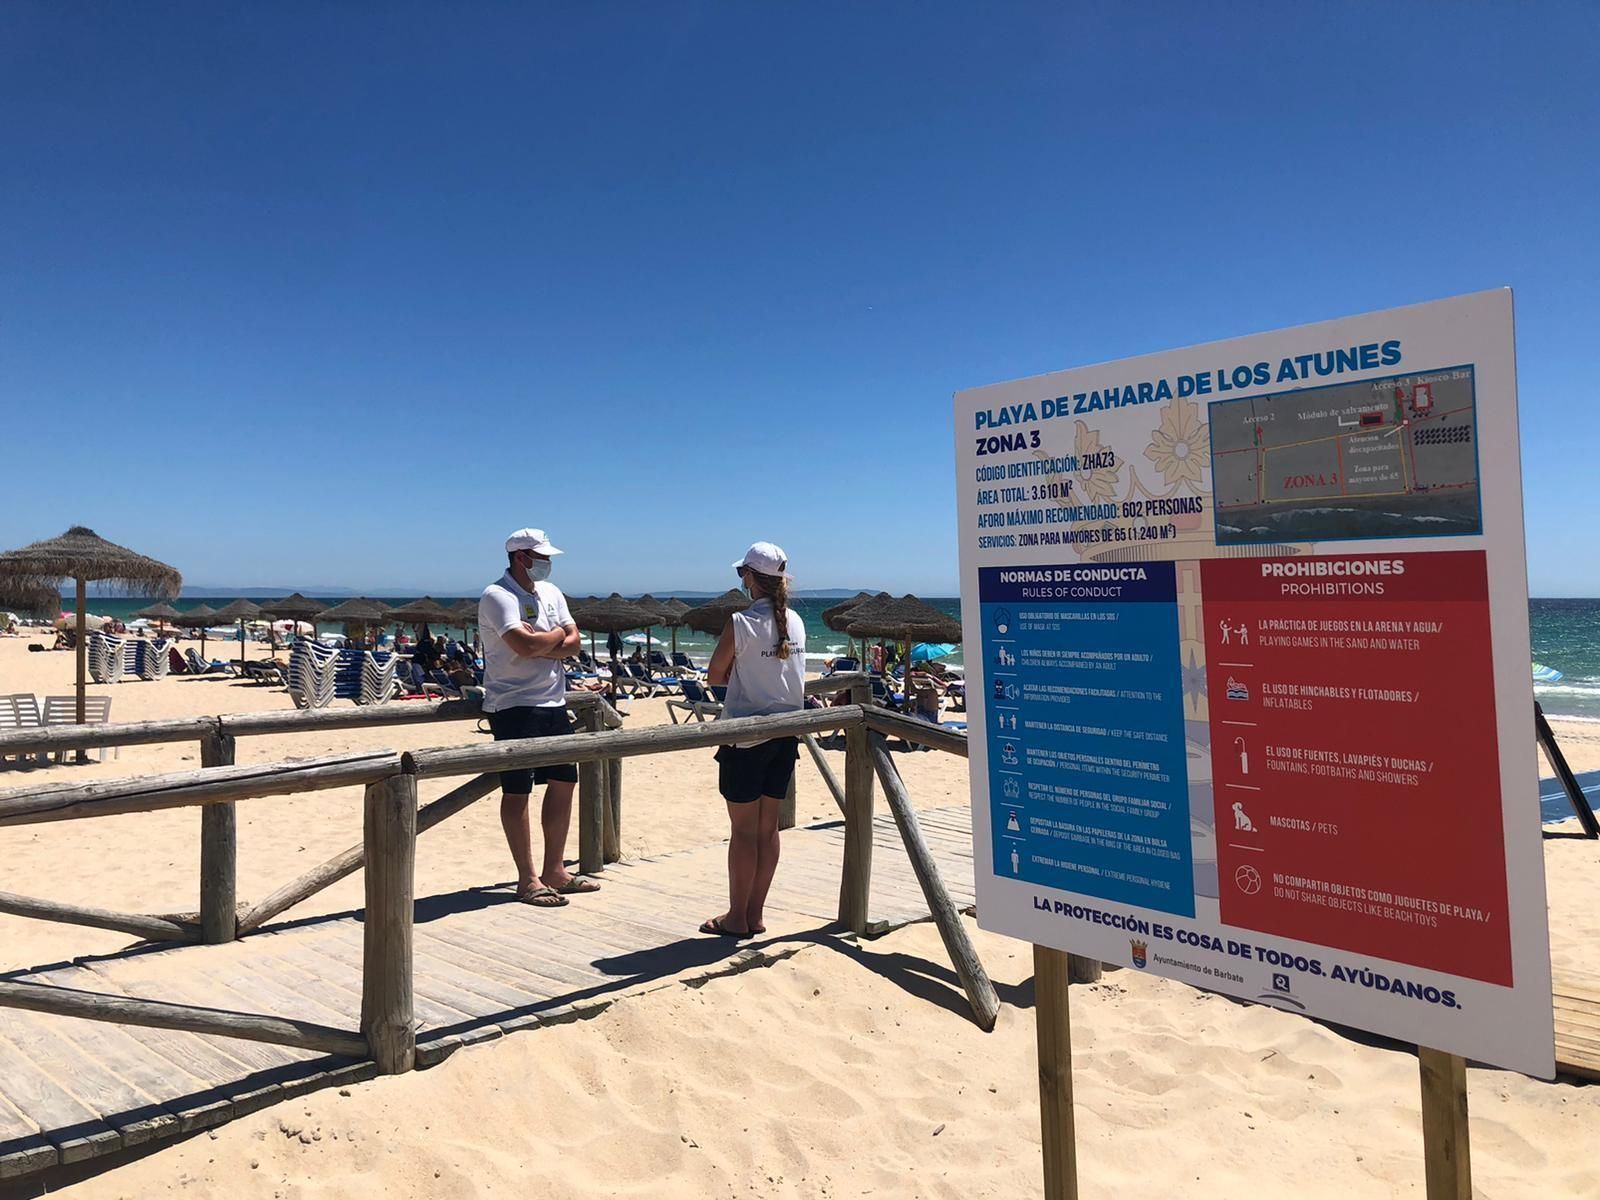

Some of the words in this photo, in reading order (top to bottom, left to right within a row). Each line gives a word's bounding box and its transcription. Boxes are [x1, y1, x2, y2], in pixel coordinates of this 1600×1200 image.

[976, 403, 1038, 430] PLAYA
[1041, 396, 1069, 419] DE
[1073, 379, 1173, 414] ZAHARA
[1177, 371, 1212, 398] DE
[1217, 362, 1270, 391] LOS
[1276, 340, 1402, 382] ATUNES
[976, 432, 1027, 456] ZONA
[1030, 430, 1040, 448] 3
[976, 465, 1006, 482] CÓDIGO
[1007, 454, 1080, 479] IDENTIFICACIÓN:
[1082, 451, 1115, 471] ZHAZ3
[1284, 474, 1326, 489] ZONA
[1330, 472, 1338, 486] 3
[977, 487, 999, 505] ÁREA
[1000, 487, 1030, 503] TOTAL:
[1031, 483, 1058, 501] 3.610
[978, 512, 1005, 528] AFORO
[1006, 508, 1043, 526] MÁXIMO
[1045, 503, 1120, 523] RECOMENDADO:
[1122, 501, 1143, 518] 602
[1145, 496, 1203, 516] PERSONAS
[978, 535, 1017, 548] SERVICIOS:
[1018, 533, 1039, 546] ZONA
[1040, 531, 1060, 545] PARA
[1062, 529, 1100, 544] MAYORES
[1101, 528, 1113, 542] DE
[1114, 528, 1127, 541] 65
[1000, 570, 1051, 583] NORMAS
[1054, 570, 1071, 582] DE
[1073, 568, 1147, 581] CONDUCTA
[1261, 560, 1405, 577] PROHIBICIONES
[1022, 588, 1053, 598] RULES
[1054, 587, 1069, 597] OF
[1070, 586, 1122, 597] CONDUCT
[1281, 582, 1384, 595] PROHIBITIONS
[1258, 619, 1268, 630] LA
[1269, 618, 1306, 631] PRÁCTICA
[1307, 620, 1318, 631] DE
[1319, 620, 1349, 631] JUEGOS
[1350, 620, 1361, 632] EN
[1362, 621, 1374, 632] LA
[1375, 621, 1404, 633] ARENA
[1405, 622, 1413, 633] Y
[1259, 635, 1291, 648] PLAYING
[1292, 636, 1319, 648] GAMES
[1320, 637, 1329, 648] IN
[1330, 637, 1345, 649] THE
[1346, 638, 1369, 650] SAND
[1370, 638, 1388, 650] AND
[1389, 639, 1420, 651] WATER
[1262, 683, 1272, 694] EL
[1272, 683, 1288, 695] USO
[1288, 684, 1299, 696] DE
[1300, 685, 1350, 698] HINCHABLES
[1350, 688, 1357, 698] Y
[1359, 689, 1412, 702] FLOTADORES
[1263, 697, 1313, 710] INFLATABLES
[1266, 745, 1274, 756] EL
[1276, 747, 1291, 758] USO
[1292, 748, 1303, 759] DE
[1343, 753, 1382, 768] LAVAPIÉS
[1383, 757, 1390, 768] Y
[1391, 758, 1427, 772] DUCHAS
[1311, 764, 1356, 779] FOOTBATHS
[1358, 769, 1375, 781] AND
[1376, 771, 1419, 786] SHOWERS
[1270, 815, 1310, 831] MASCOTAS
[1318, 822, 1338, 835] PETS
[1273, 873, 1284, 884] NO
[1285, 874, 1330, 892] COMPARTIR
[1331, 883, 1366, 899] OBJETOS
[1367, 890, 1392, 904] COMO
[1393, 895, 1438, 912] JUGUETES
[1439, 903, 1452, 916] DE
[1453, 906, 1483, 922] PLAYA
[1273, 886, 1284, 897] DO
[1285, 888, 1300, 900] NOT
[1301, 891, 1327, 906] SHARE
[1328, 896, 1363, 912] OBJECTS
[1364, 903, 1383, 917] LIKE
[1383, 906, 1413, 923] BEACH
[1414, 913, 1437, 928] TOYS
[1033, 896, 1052, 912] LA
[1054, 901, 1150, 935] PROTECCIÓN
[1152, 923, 1174, 941] ES
[1176, 929, 1224, 953] COSA
[1227, 940, 1252, 959] DE
[1255, 947, 1326, 977] TODOS.
[1331, 965, 1461, 1010] AYÚDANOS.
[1153, 953, 1201, 973] Ayuntamiento
[1202, 965, 1212, 975] de
[1213, 968, 1243, 983] Barbate
